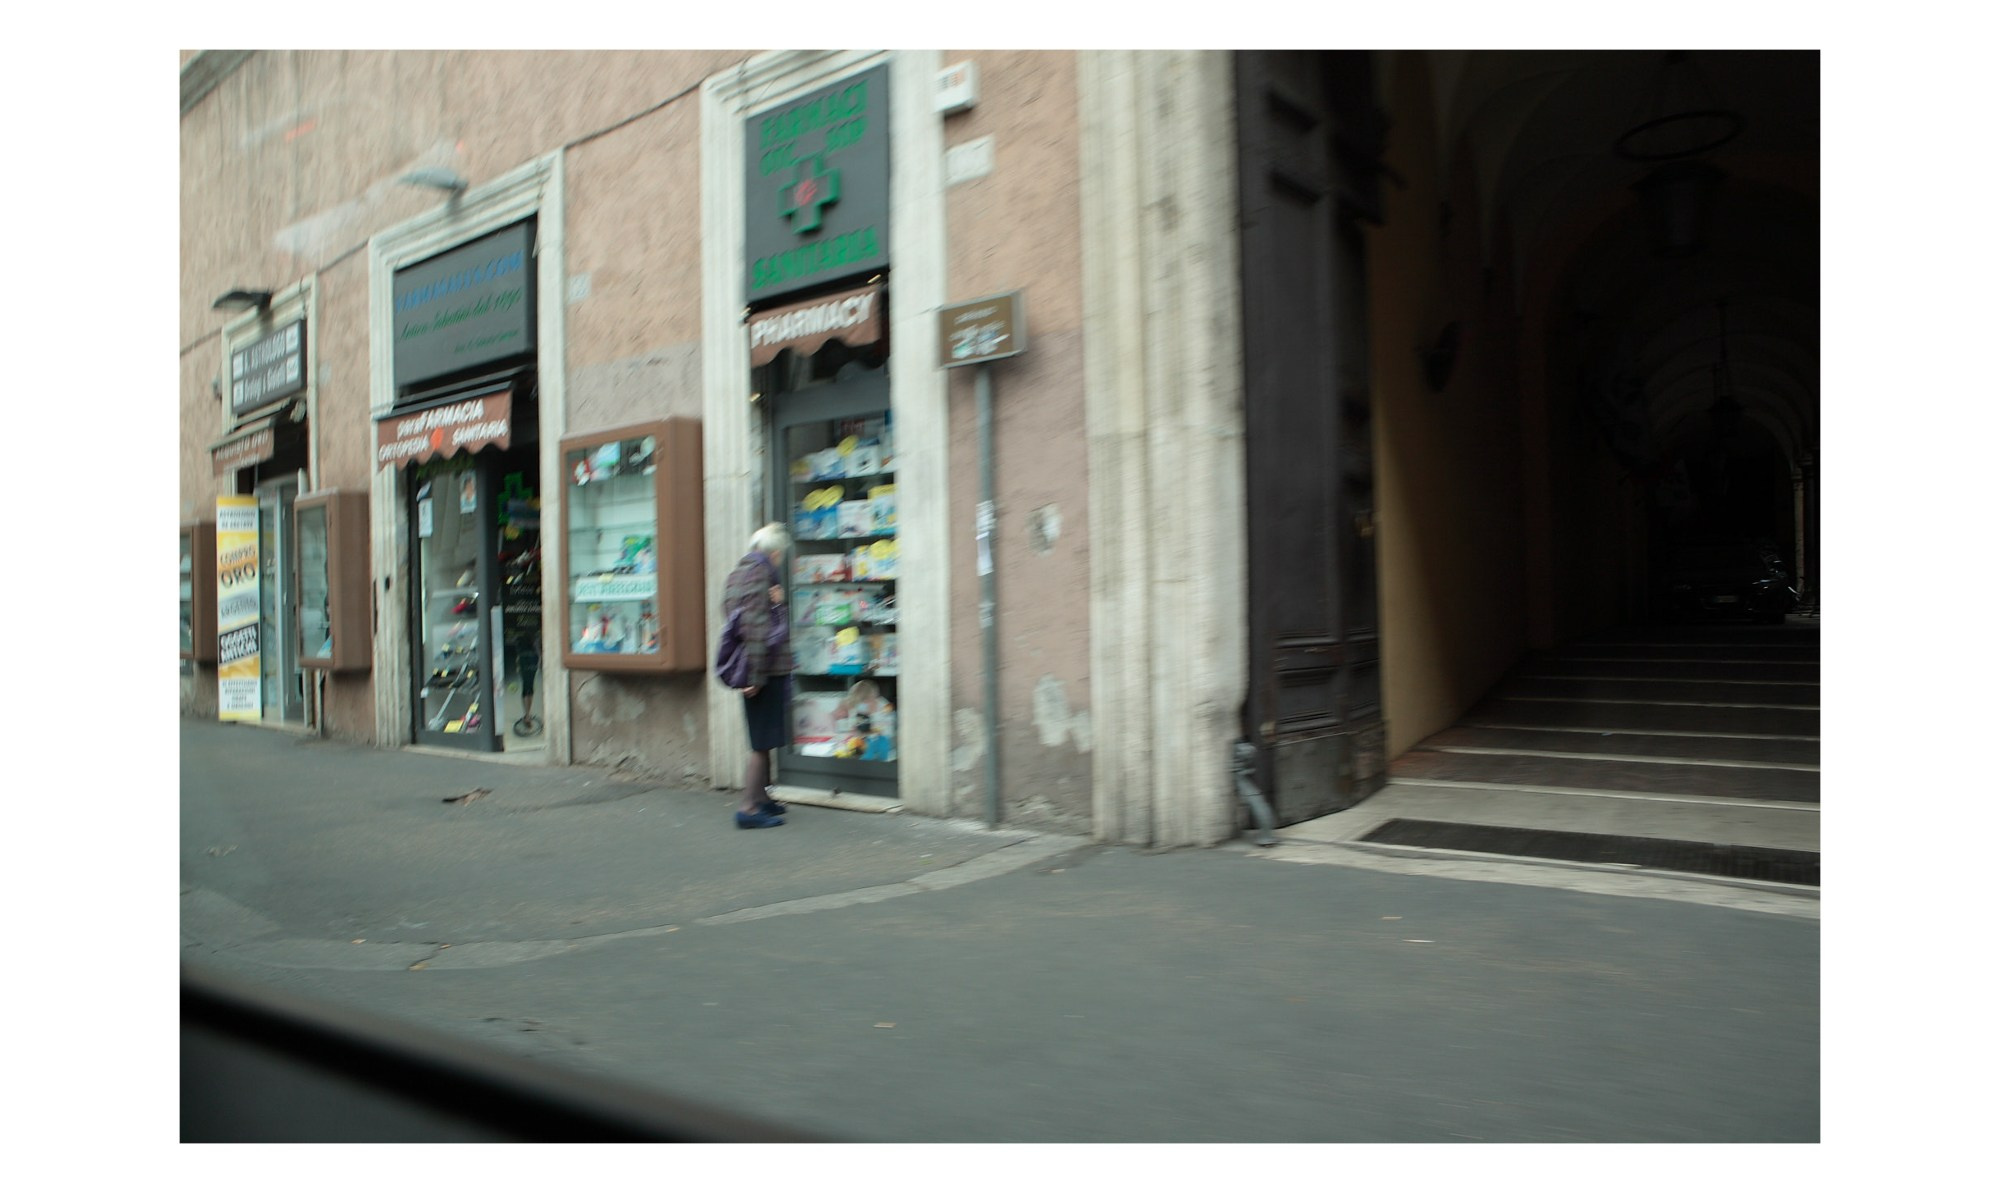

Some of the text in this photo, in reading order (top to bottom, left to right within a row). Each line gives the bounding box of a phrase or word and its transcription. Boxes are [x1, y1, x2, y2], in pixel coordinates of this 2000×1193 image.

[752, 225, 880, 290] SANITARIA
[751, 291, 876, 349] PHARMACY
[379, 418, 508, 462] ORTOPEDIA SANITARIA
[397, 399, 484, 440] paraFARMACIA
[221, 561, 256, 588] ORO
